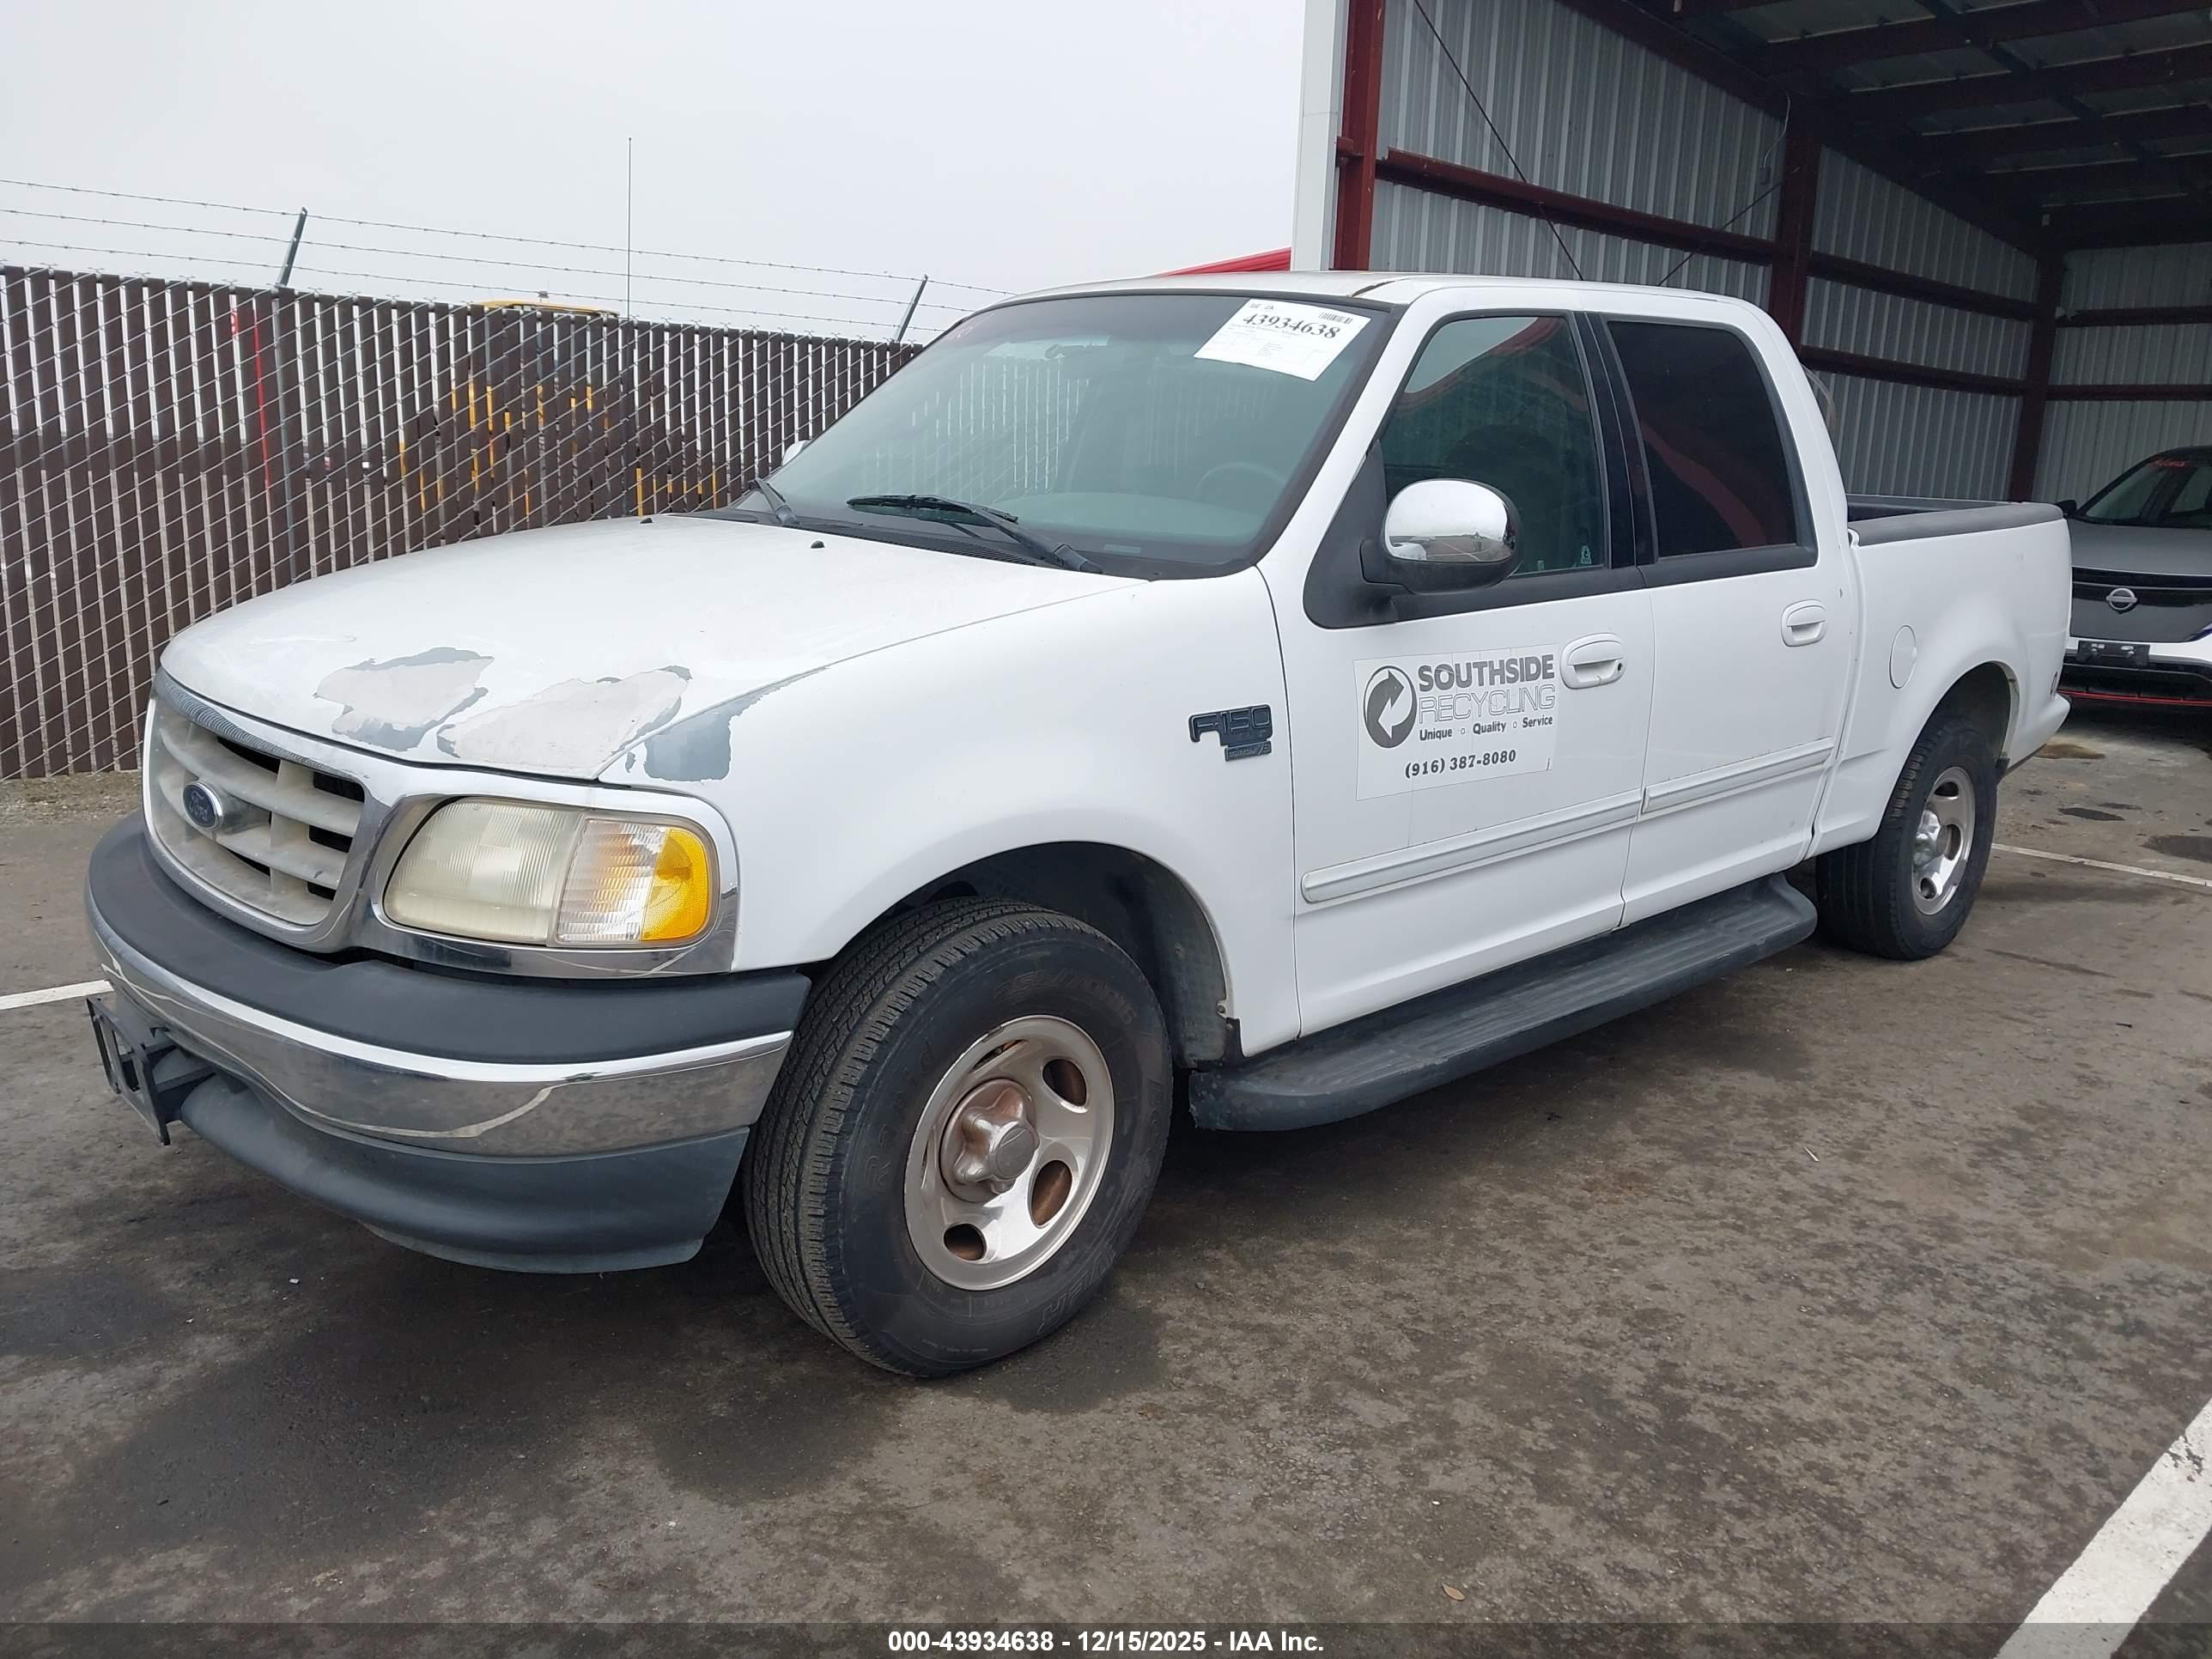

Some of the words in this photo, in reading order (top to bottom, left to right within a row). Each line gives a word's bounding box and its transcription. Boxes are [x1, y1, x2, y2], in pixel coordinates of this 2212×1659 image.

[1243, 313, 1340, 339] 43934638
[1418, 653, 1555, 692] SOUTHSIDE
[1419, 684, 1556, 724] RECYCLING
[1419, 728, 1453, 742] Unique
[1473, 720, 1507, 735] Quality
[1522, 714, 1553, 729] Service
[1405, 757, 1445, 779] (916)
[1449, 750, 1516, 771] 387-8080
